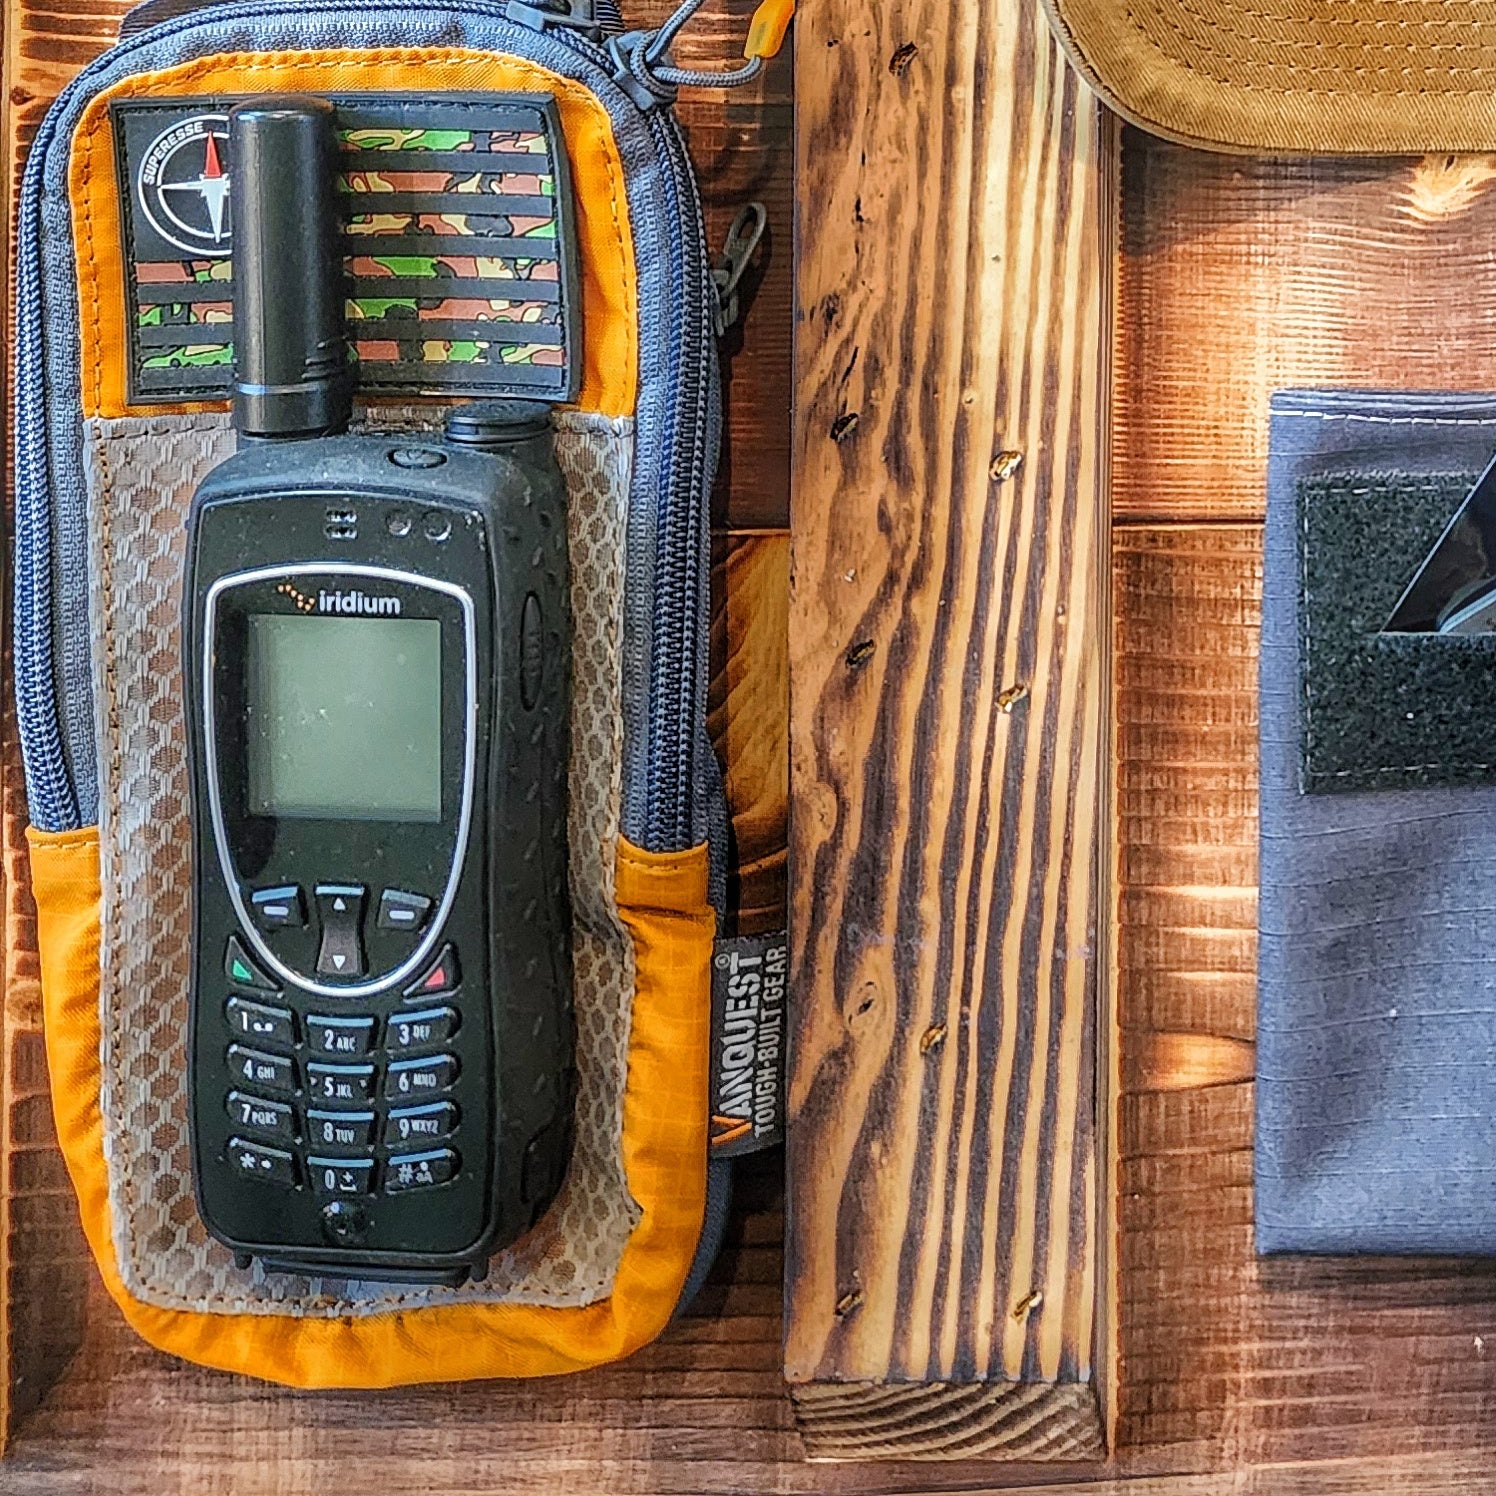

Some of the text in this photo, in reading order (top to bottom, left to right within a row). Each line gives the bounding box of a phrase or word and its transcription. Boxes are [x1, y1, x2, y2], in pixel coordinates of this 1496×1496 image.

[143, 121, 204, 186] SUPERESSE
[319, 590, 400, 614] iridium
[763, 945, 787, 1003] GEAR
[324, 1029, 334, 1050] 2
[399, 1024, 410, 1045] 3
[242, 1059, 253, 1080] 4
[323, 1076, 334, 1097] 5
[398, 1072, 409, 1092] 6
[241, 1104, 251, 1124] 7
[323, 1122, 334, 1142] 8
[399, 1118, 410, 1139] 9
[324, 1169, 335, 1190] 0
